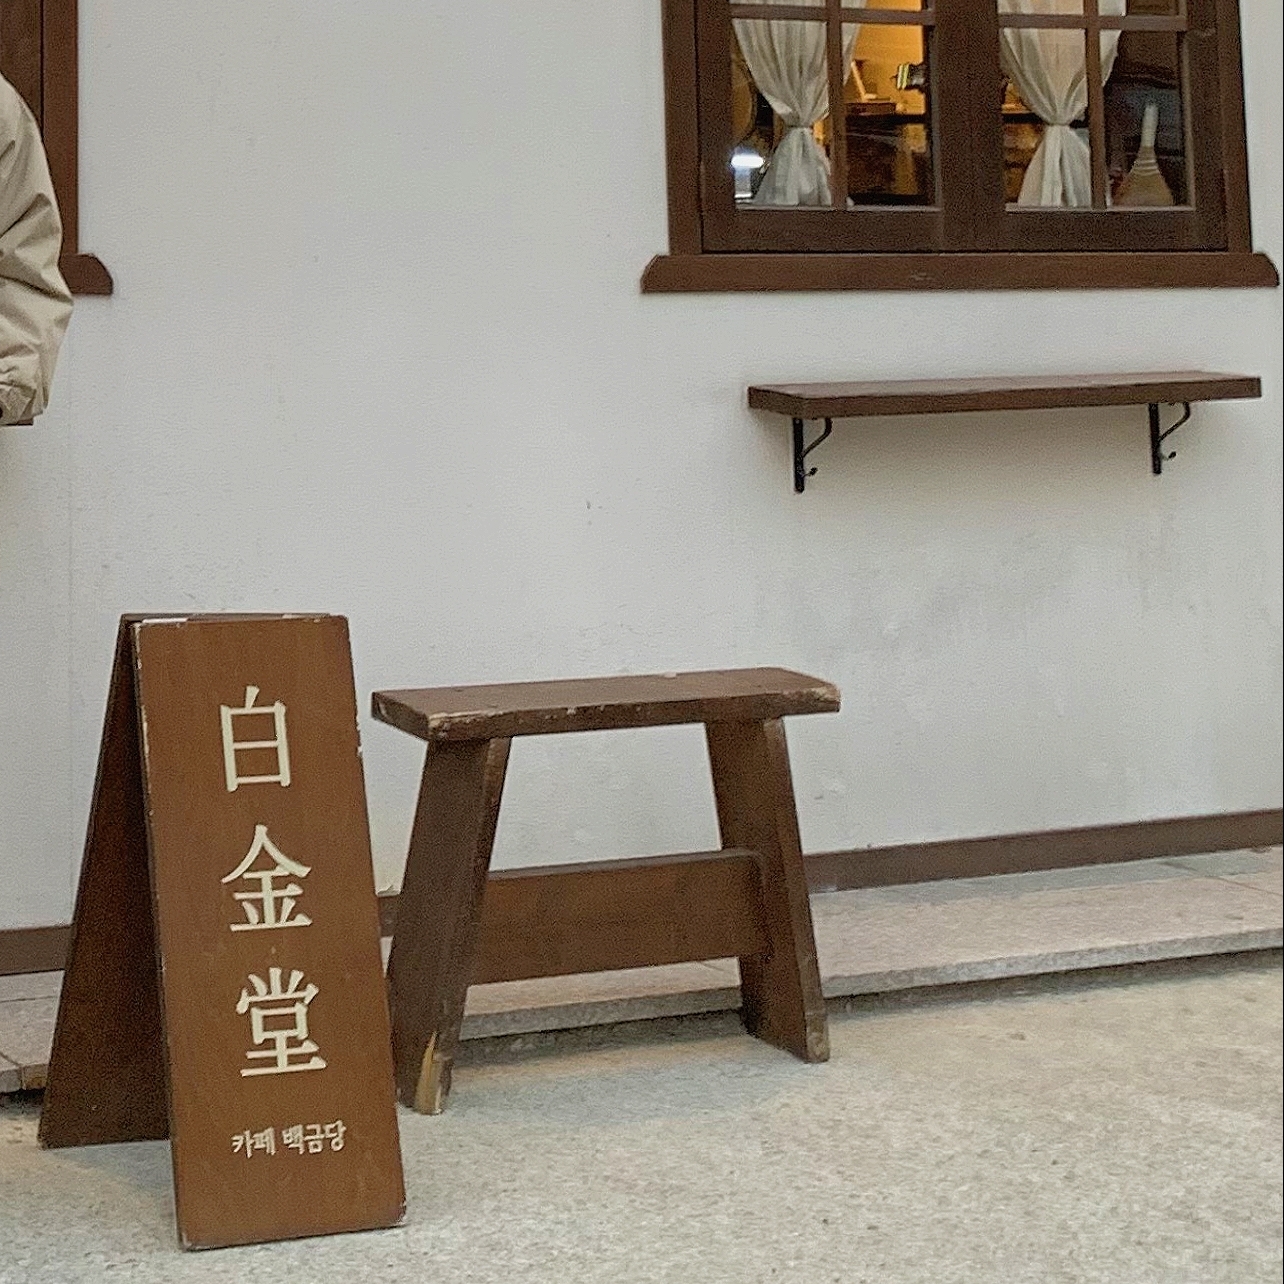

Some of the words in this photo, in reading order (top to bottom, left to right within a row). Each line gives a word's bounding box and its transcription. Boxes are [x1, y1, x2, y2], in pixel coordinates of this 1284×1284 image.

[219, 685, 328, 1078] 白金堂
[231, 1126, 276, 1158] 카페
[282, 1120, 347, 1155] 백금당
